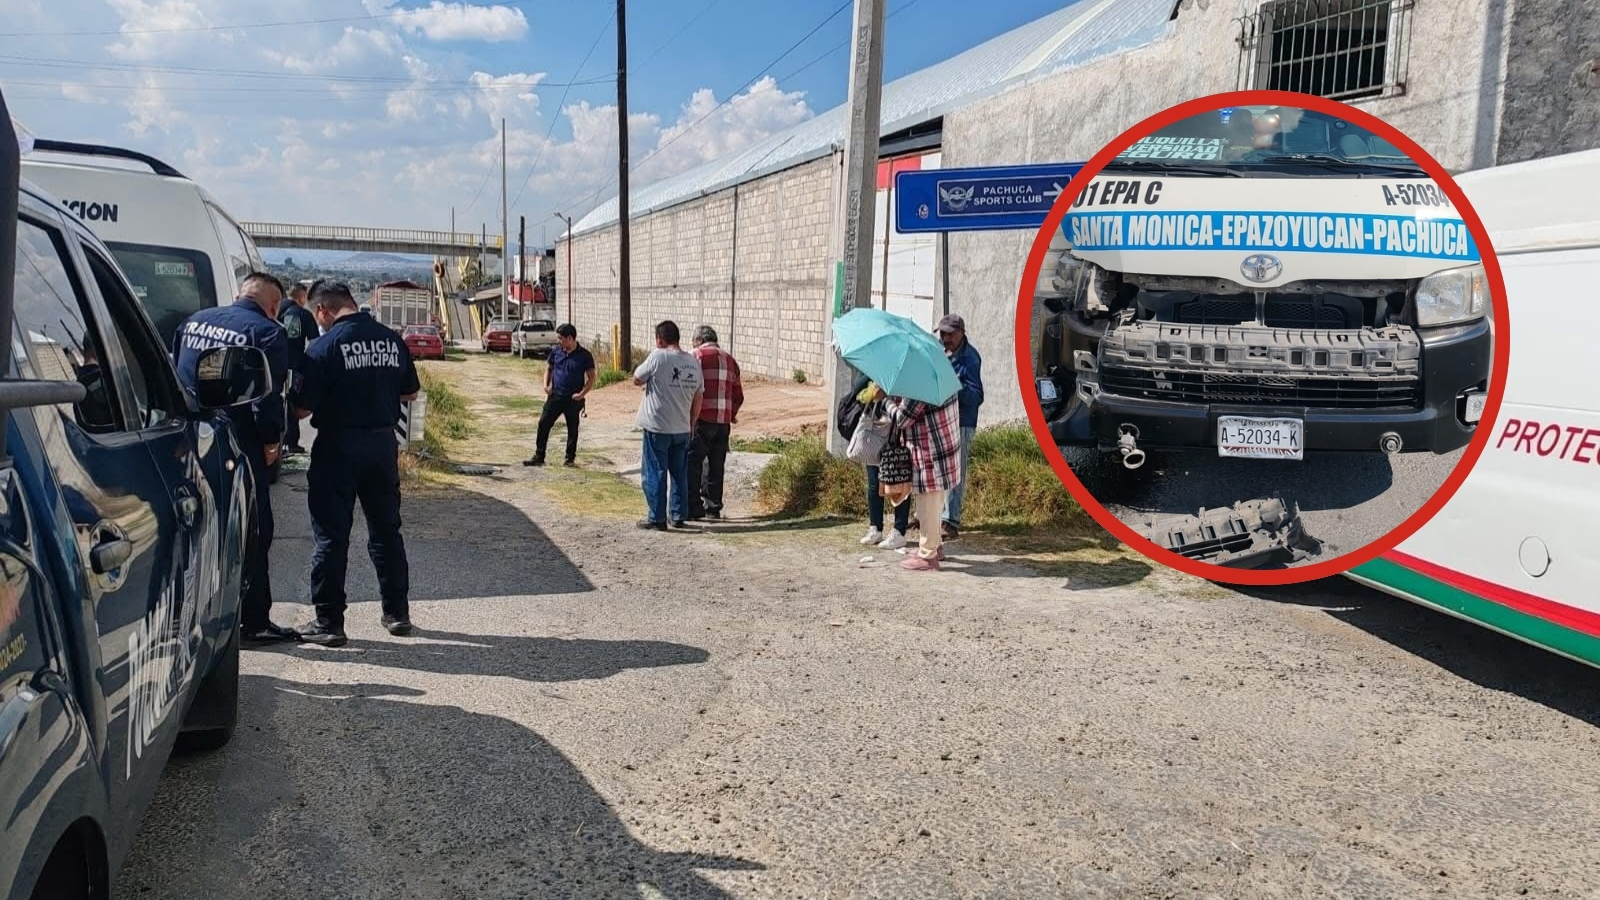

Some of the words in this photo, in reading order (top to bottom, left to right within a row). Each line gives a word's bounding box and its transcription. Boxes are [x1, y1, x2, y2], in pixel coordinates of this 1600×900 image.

[983, 185, 1033, 195] PACHUCA
[1099, 181, 1141, 205] EPA
[1144, 181, 1163, 205] C
[973, 195, 1013, 206] SPORTS
[1015, 194, 1042, 204] CLUB
[1071, 215, 1123, 246] SANTA
[340, 338, 399, 356] POLICÍA
[344, 353, 400, 370] MUNICIPAL
[1221, 427, 1298, 446] A-52034-K
[1496, 418, 1600, 465] PROTE
